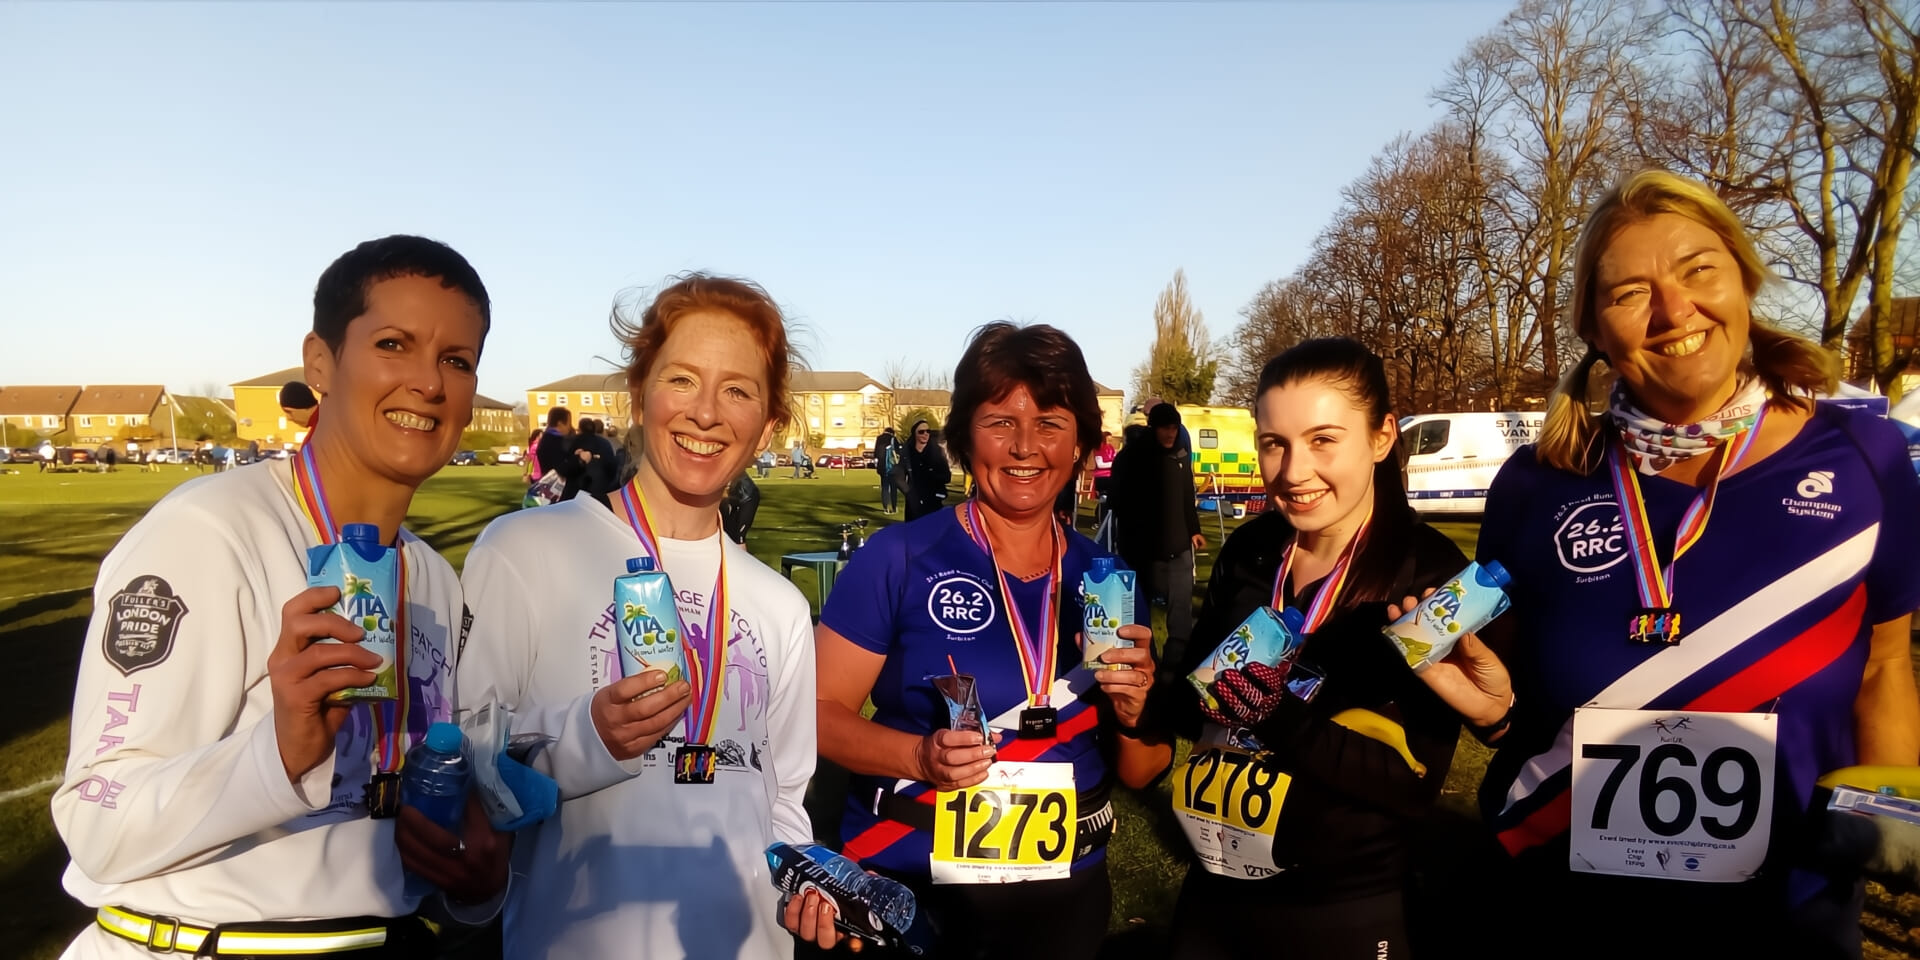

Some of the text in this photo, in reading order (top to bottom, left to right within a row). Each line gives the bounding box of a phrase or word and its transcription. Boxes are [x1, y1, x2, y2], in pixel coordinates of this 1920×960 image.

[1496, 420, 1543, 428] ST ALB
[1501, 429, 1530, 437] VAN
[1782, 498, 1842, 512] Champion
[1788, 506, 1834, 519] System
[1567, 518, 1624, 539] 26.2
[1572, 534, 1622, 559] RRC
[940, 588, 984, 607] 26.2
[1435, 586, 1461, 621] VITA
[116, 607, 171, 627] LONDON
[942, 605, 982, 621] RRC
[1086, 617, 1118, 629] COCO
[1428, 599, 1460, 634] COCO
[120, 620, 160, 634] PRIDE
[622, 615, 666, 636] VITA
[730, 608, 757, 646] TCH
[632, 628, 676, 647] COCO
[1228, 631, 1250, 665] VITA
[411, 623, 453, 678] PATCH
[590, 645, 600, 692] ESTABL
[1183, 748, 1279, 829] 1278
[1582, 743, 1761, 841] 769
[946, 789, 1068, 862] 1273
